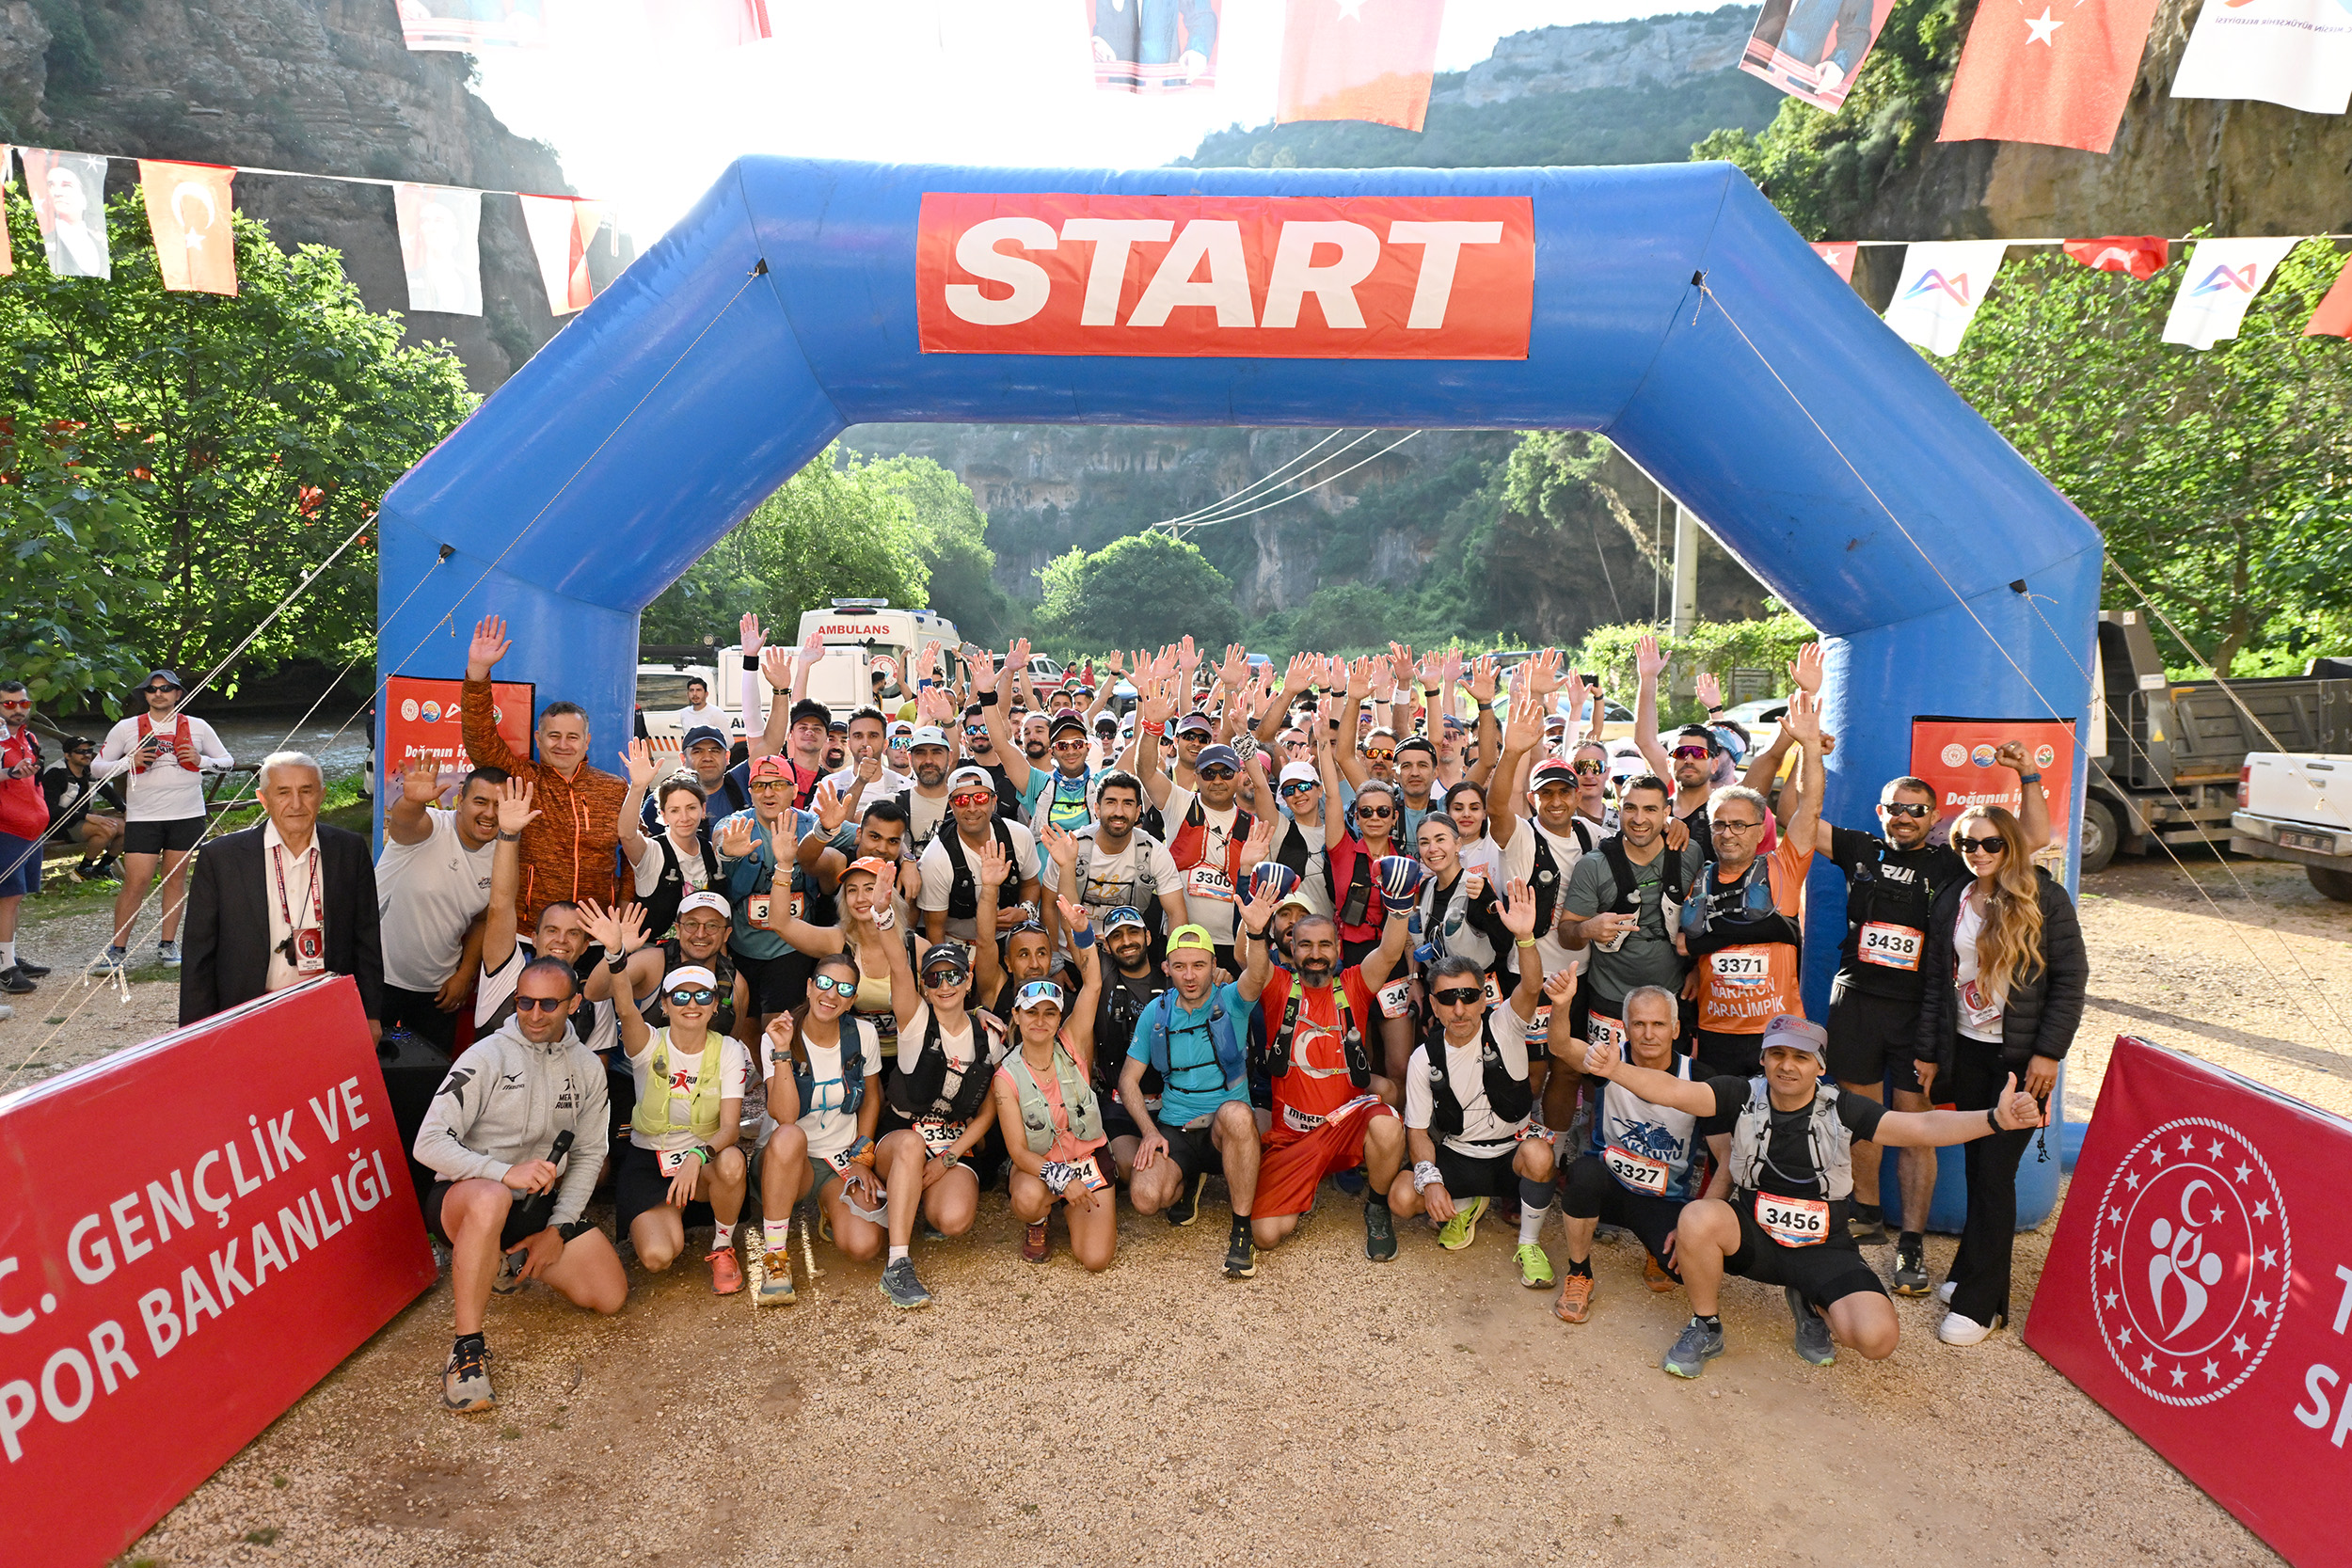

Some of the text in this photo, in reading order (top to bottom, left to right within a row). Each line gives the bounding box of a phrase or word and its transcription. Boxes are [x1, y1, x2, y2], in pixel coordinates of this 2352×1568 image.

[945, 217, 1504, 329] START
[818, 625, 891, 636] AMBULANS
[1946, 791, 2010, 808] Doğanın
[1196, 871, 1232, 888] 3306
[1867, 932, 1915, 954] 3438
[1718, 958, 1762, 974] 3371
[1708, 993, 1787, 1019] PARALİMPİK
[67, 1108, 307, 1286] GENÇLİK
[308, 1076, 371, 1145] VE
[1612, 1159, 1660, 1184] 3327
[1766, 1208, 1820, 1231] 3456
[137, 1148, 393, 1359] BAKANLIĞI
